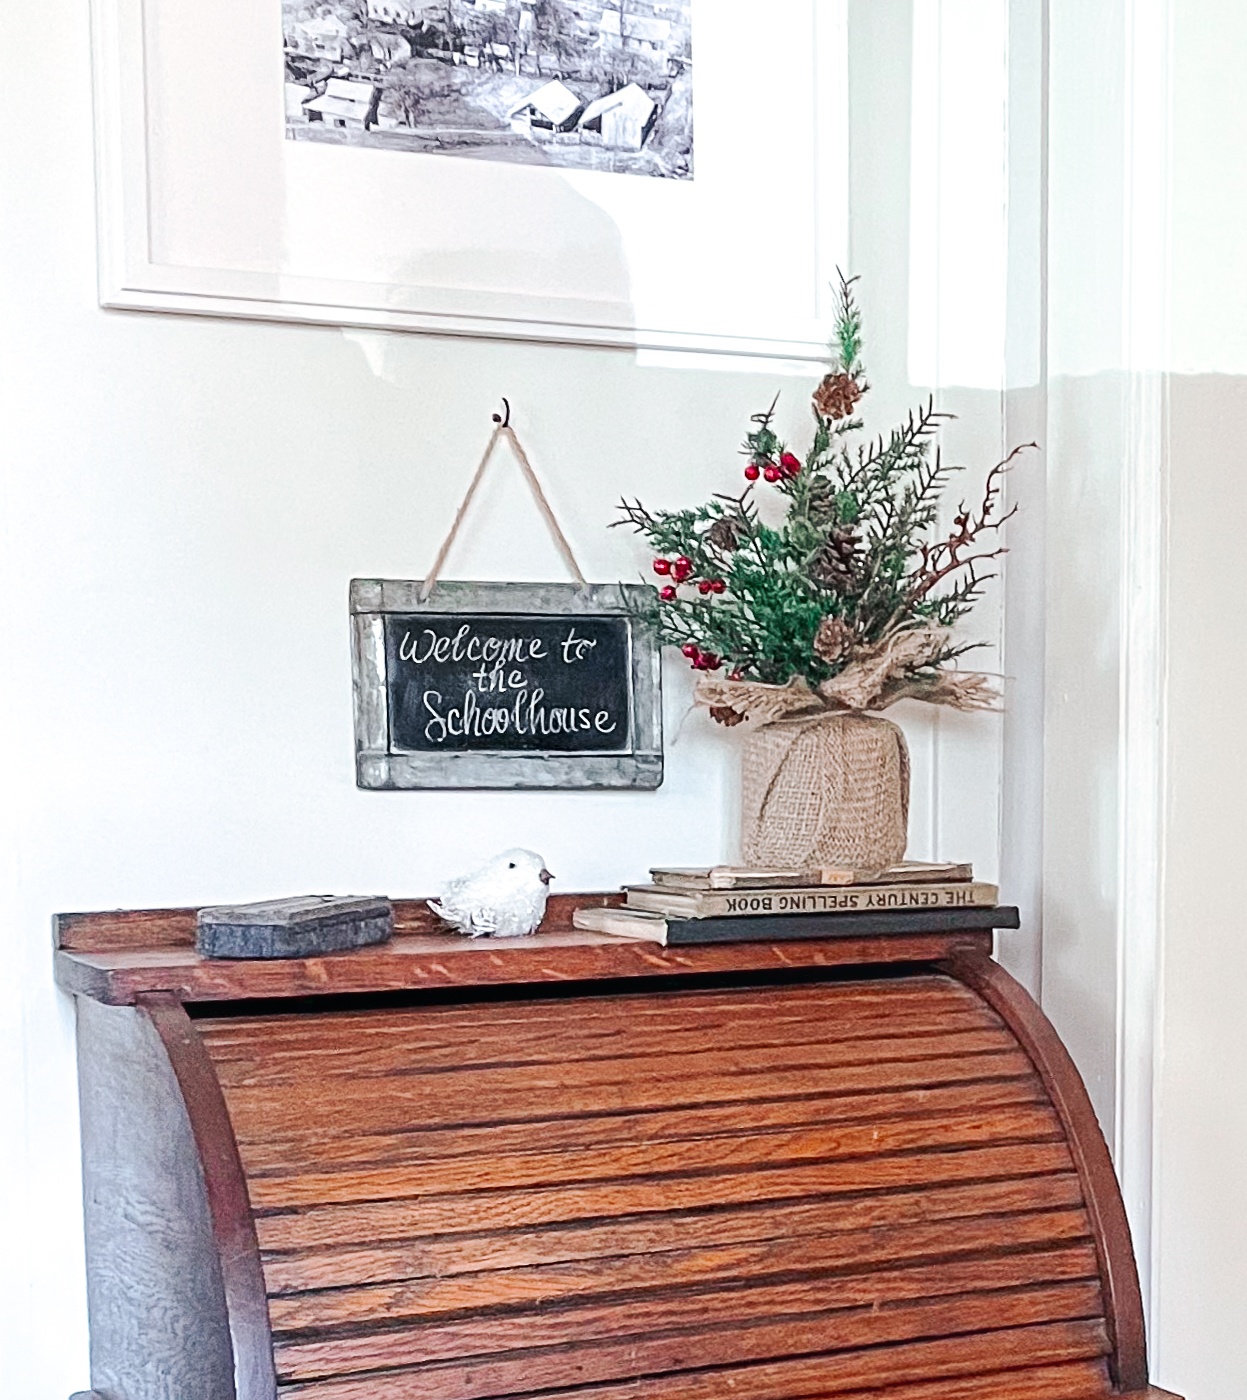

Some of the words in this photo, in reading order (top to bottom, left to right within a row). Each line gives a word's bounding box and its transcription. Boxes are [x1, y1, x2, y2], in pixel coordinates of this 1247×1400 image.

[399, 624, 548, 664] Welcome
[561, 627, 597, 664] to
[472, 658, 528, 693] the
[422, 688, 617, 742] Schoolhouse
[725, 897, 773, 912] BOOK
[780, 895, 859, 910] SPELLING
[865, 892, 939, 909] CENTURY
[944, 890, 975, 905] THE
